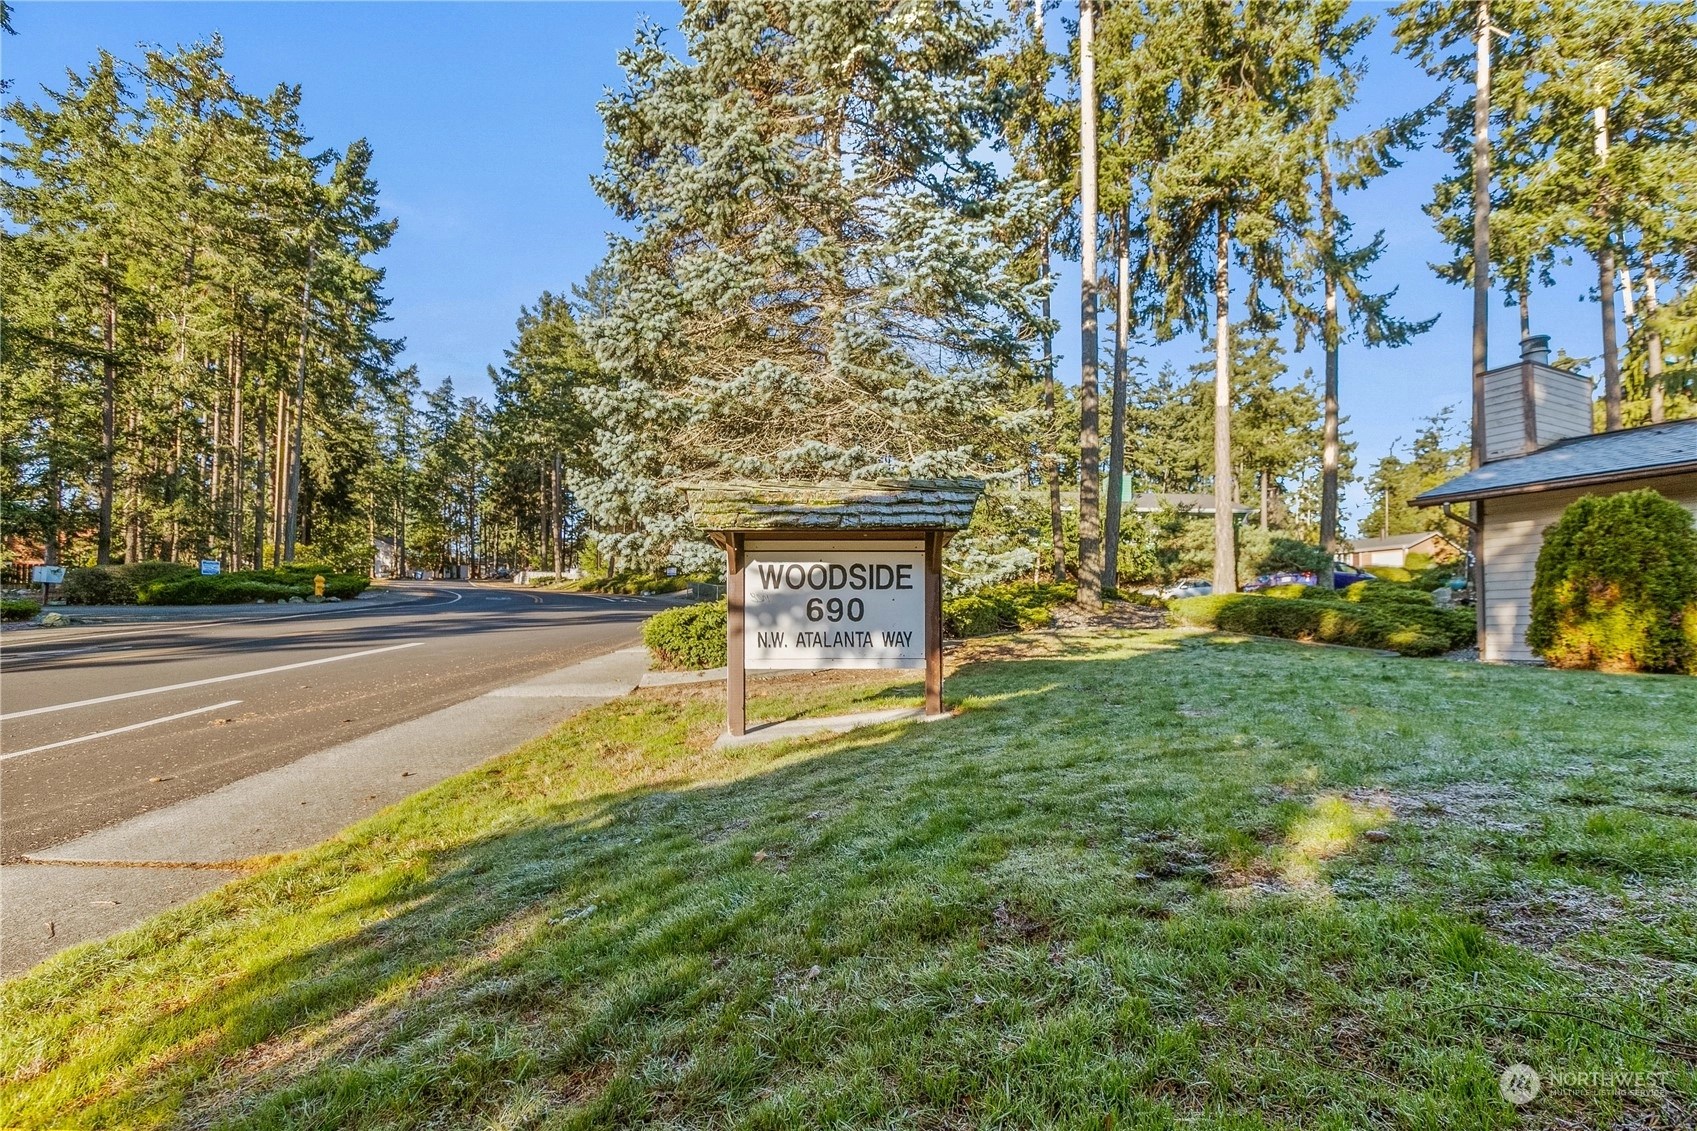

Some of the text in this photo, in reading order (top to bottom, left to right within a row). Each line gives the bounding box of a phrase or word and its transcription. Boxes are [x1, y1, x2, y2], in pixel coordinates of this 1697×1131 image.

[758, 563, 913, 591] WOODSIDE
[806, 597, 864, 622] 690
[757, 631, 913, 648] N.W. ATALANTA WAY
